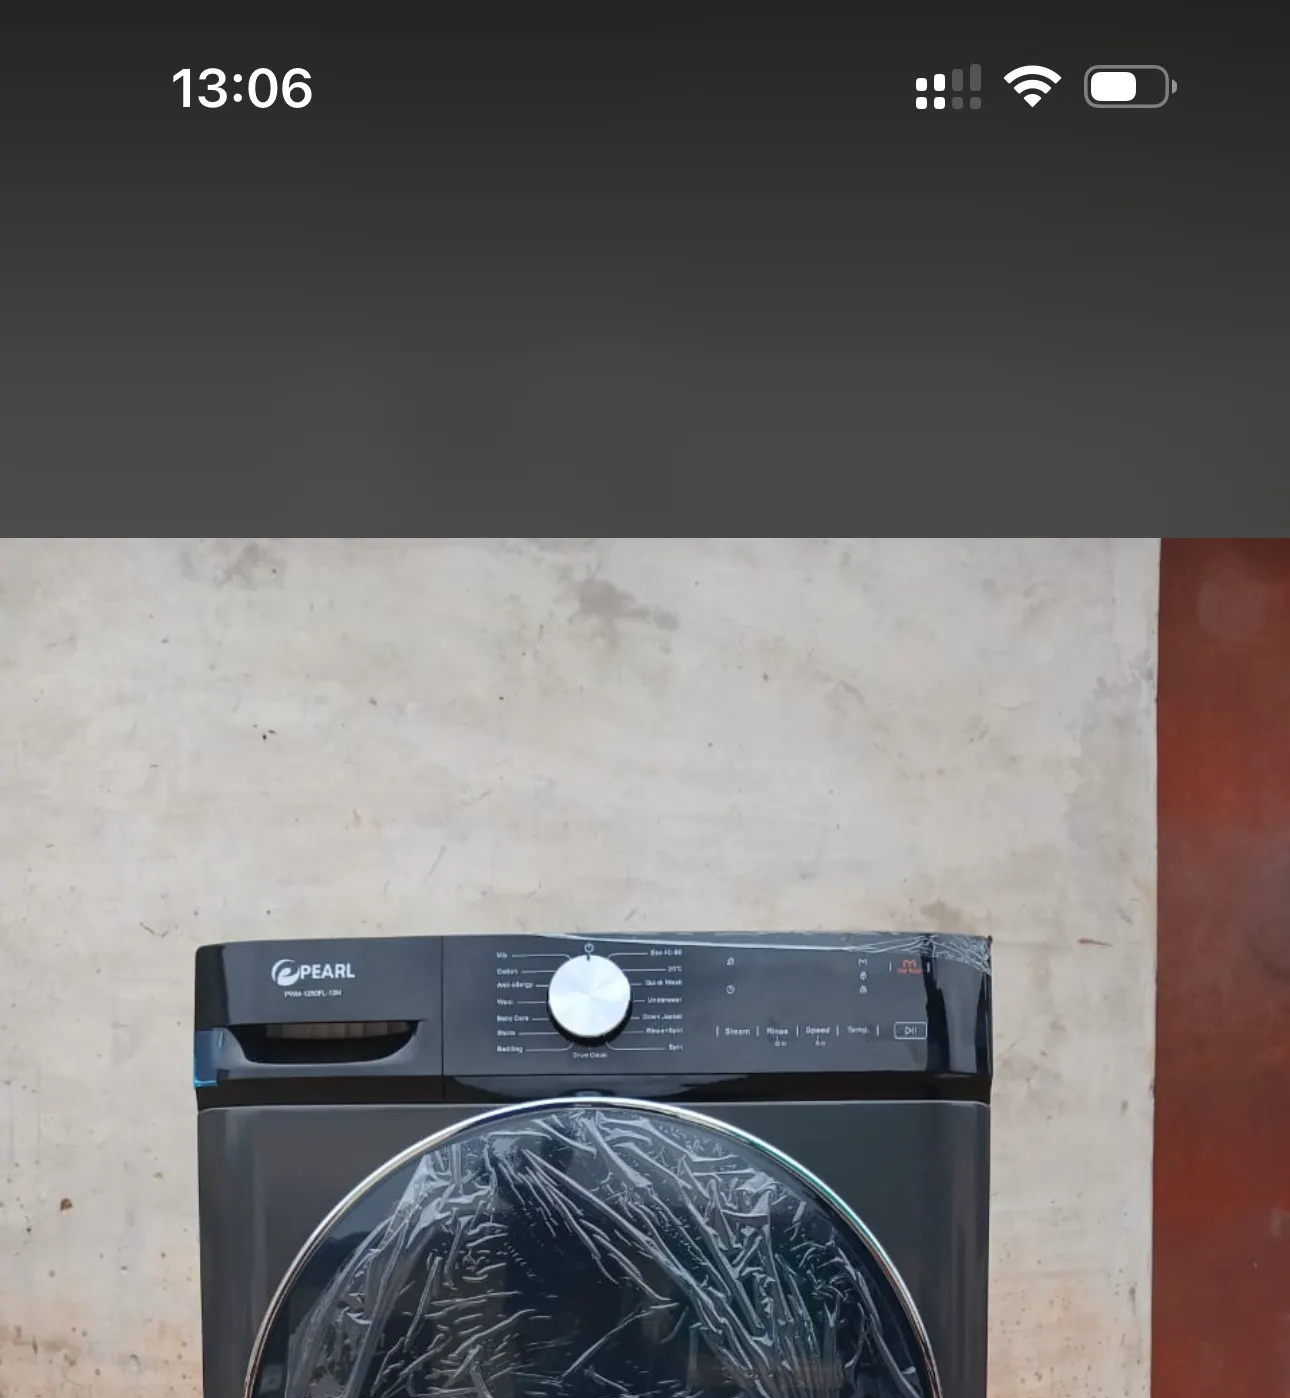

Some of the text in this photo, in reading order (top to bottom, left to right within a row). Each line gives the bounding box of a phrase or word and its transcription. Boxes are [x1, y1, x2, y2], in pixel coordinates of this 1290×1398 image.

[299, 963, 356, 980] PEARL
[724, 1027, 751, 1036] Steam
[766, 1027, 789, 1036] Rinse
[805, 1026, 831, 1037] Speed
